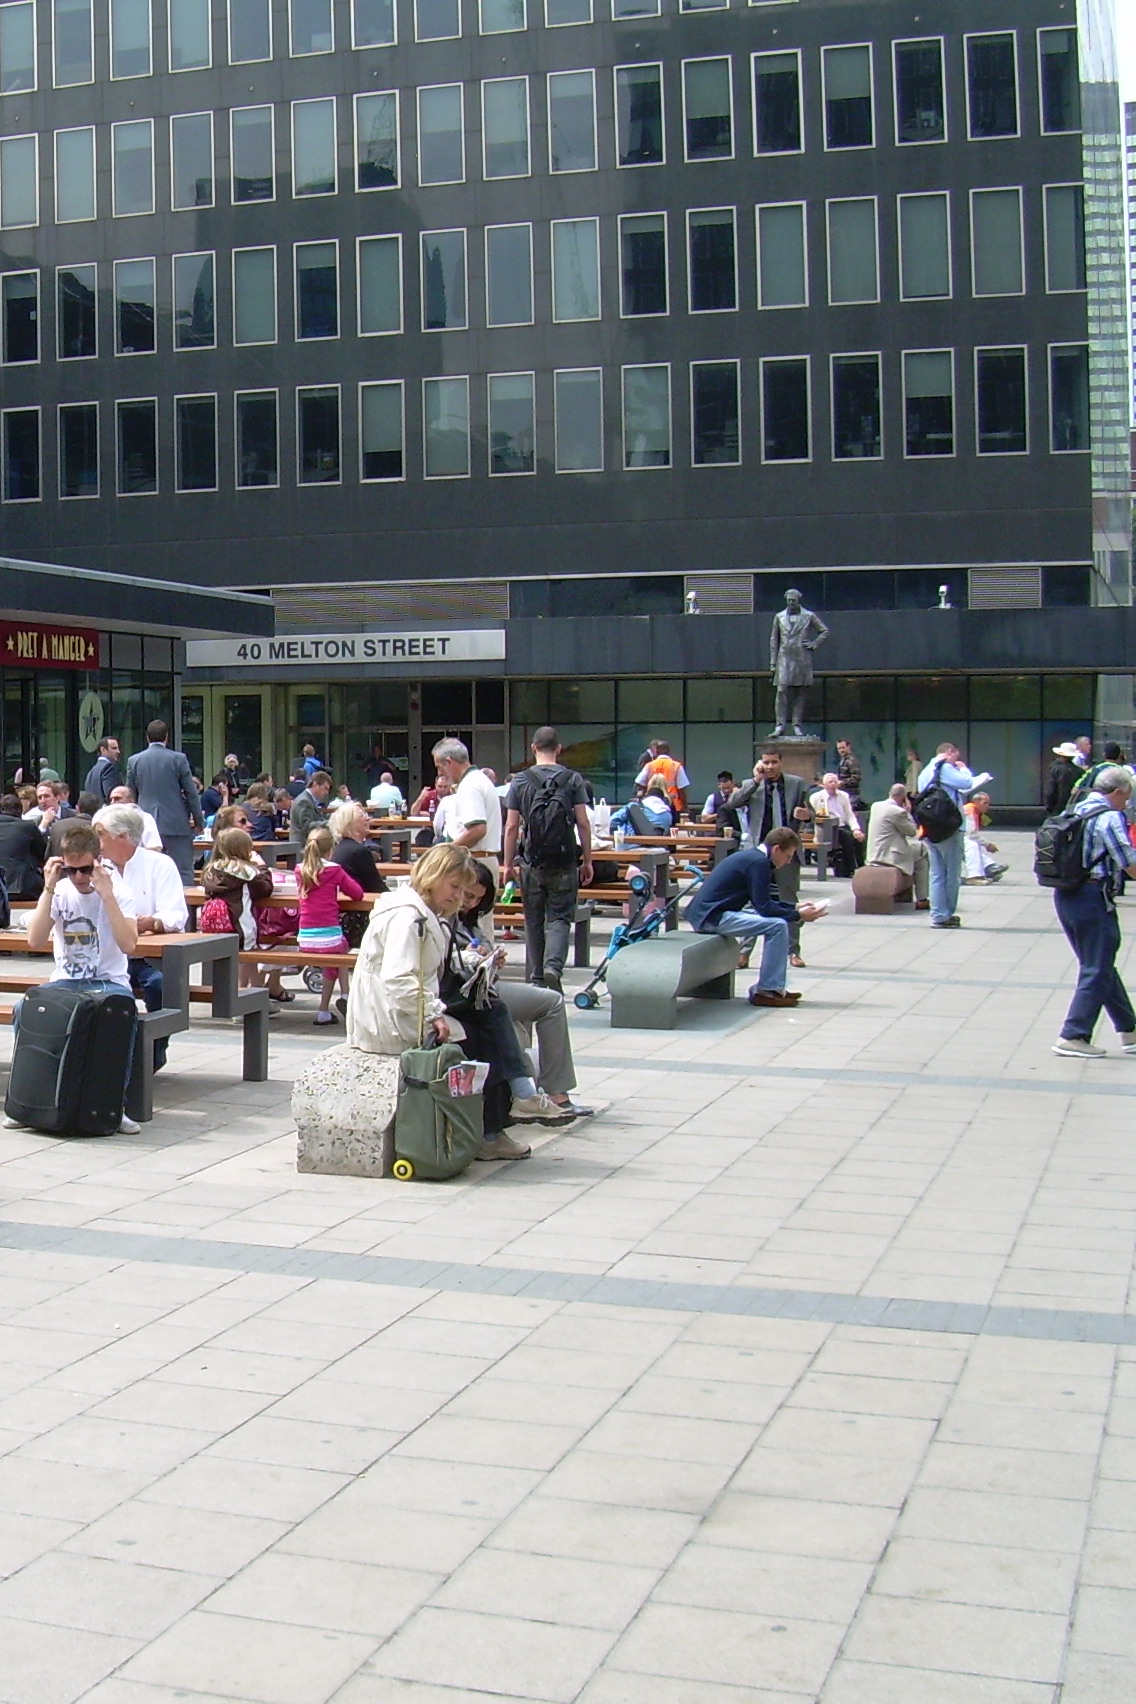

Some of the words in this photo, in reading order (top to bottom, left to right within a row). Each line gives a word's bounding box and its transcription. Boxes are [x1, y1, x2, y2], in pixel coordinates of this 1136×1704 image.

[17, 631, 39, 658] PRET
[51, 634, 86, 662] MANGER
[237, 643, 262, 660] 40
[269, 639, 356, 660] MELTON
[363, 637, 451, 657] STREET
